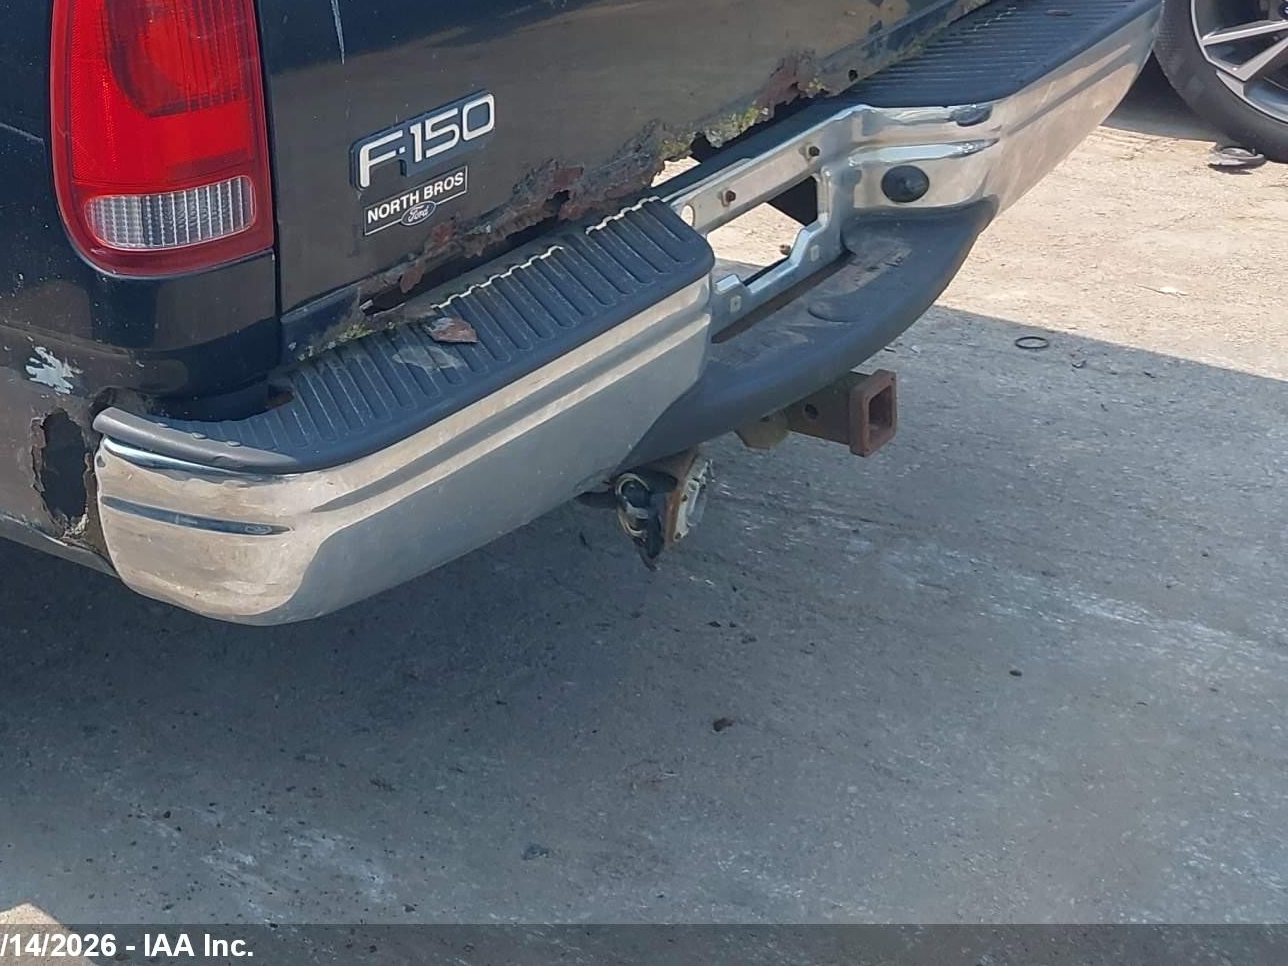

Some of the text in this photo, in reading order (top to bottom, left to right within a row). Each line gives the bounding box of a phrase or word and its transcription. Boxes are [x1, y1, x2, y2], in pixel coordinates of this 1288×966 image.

[359, 92, 495, 188] F-150
[366, 171, 465, 224] NORTH BROS
